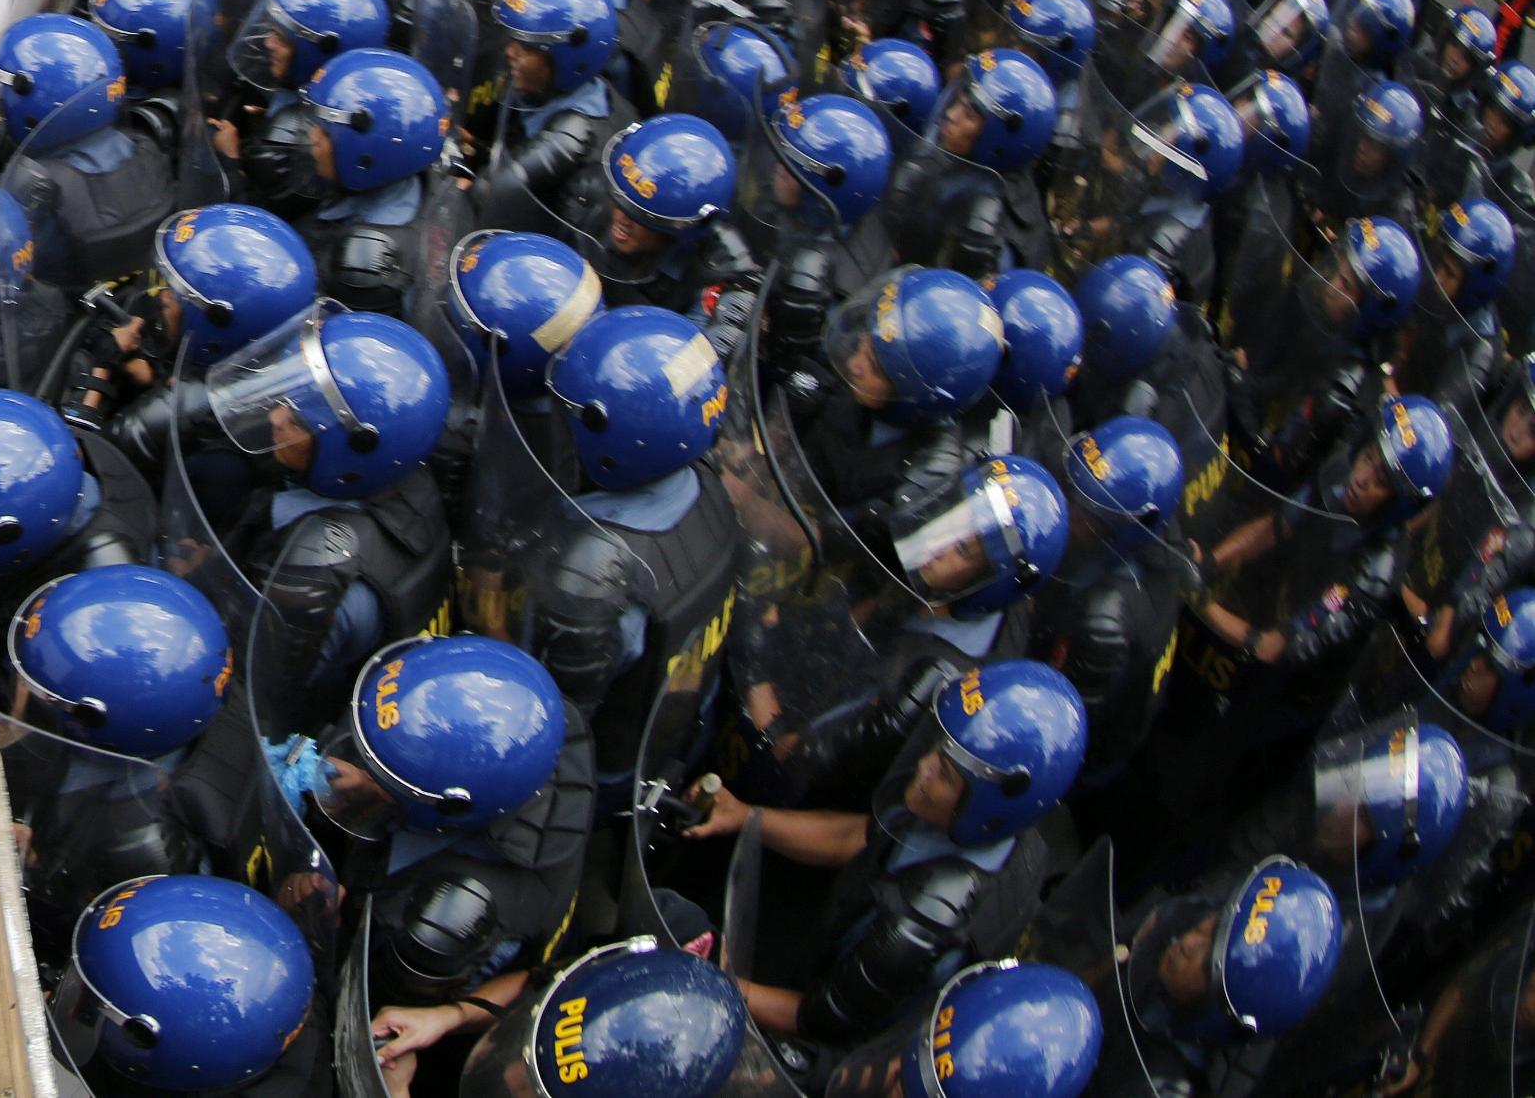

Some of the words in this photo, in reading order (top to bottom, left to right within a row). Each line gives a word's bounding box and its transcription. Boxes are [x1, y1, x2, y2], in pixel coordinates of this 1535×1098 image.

[702, 384, 728, 427] PNP
[376, 658, 405, 730] PULIS
[1243, 876, 1283, 945] PULIS
[555, 996, 589, 1084] PULIS
